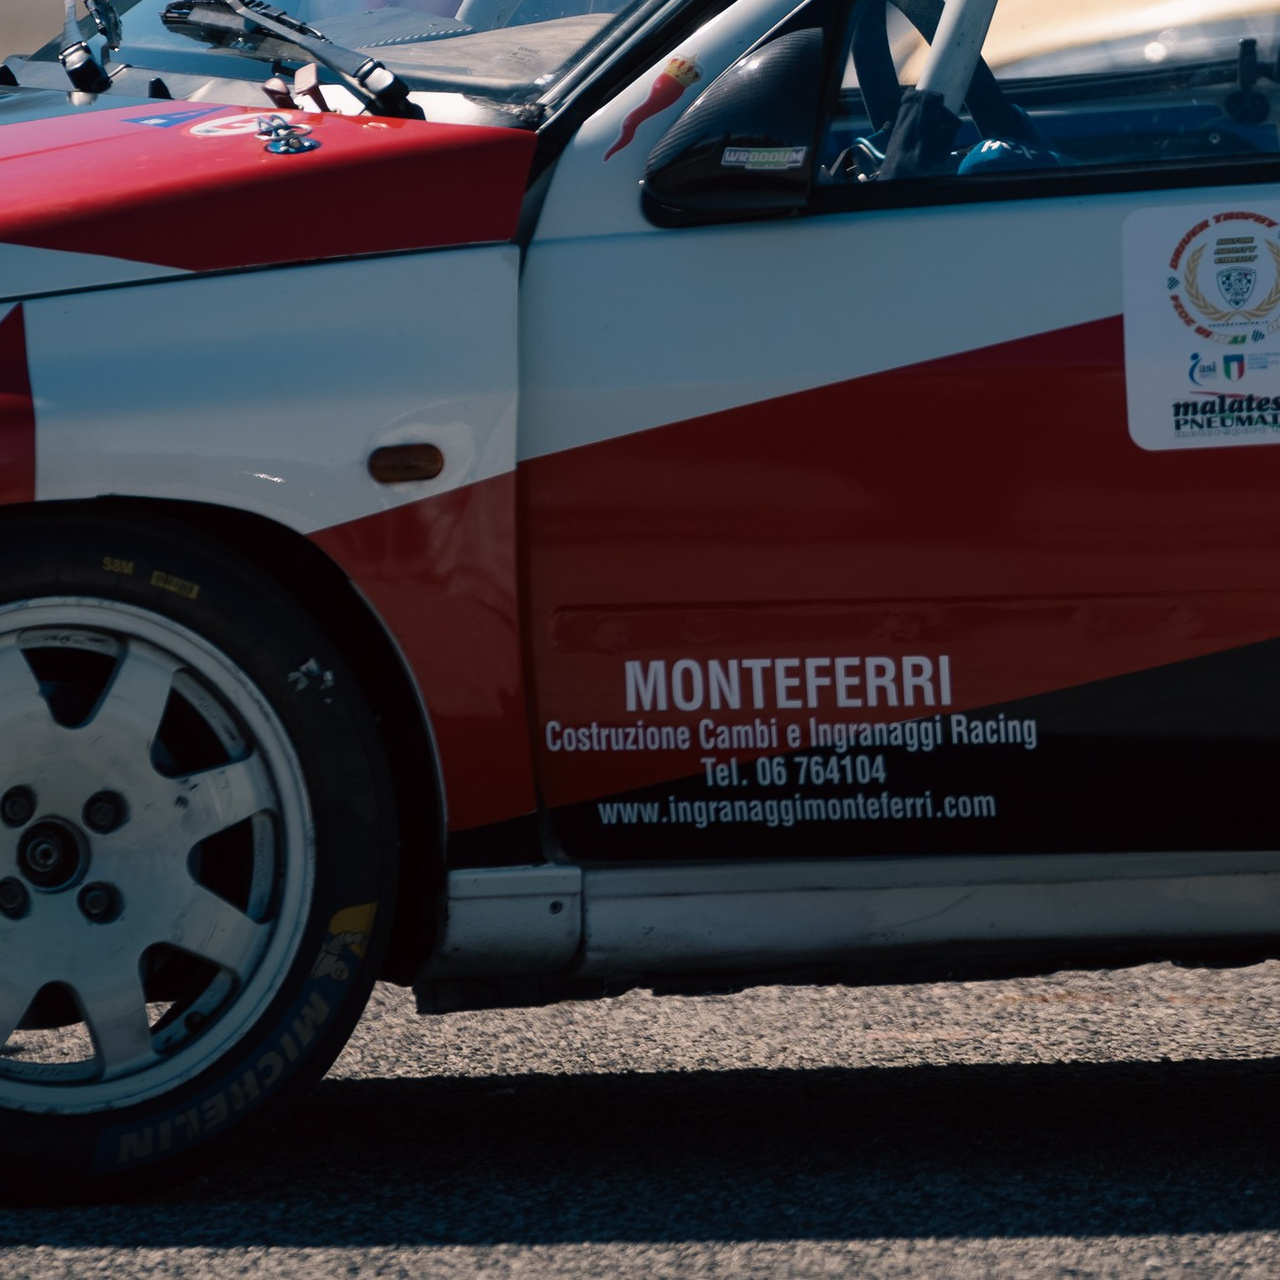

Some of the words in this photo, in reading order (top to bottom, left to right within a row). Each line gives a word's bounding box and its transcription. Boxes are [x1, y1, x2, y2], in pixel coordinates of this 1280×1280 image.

[1169, 218, 1210, 270] DRIVER
[1212, 211, 1279, 228] TROPHY
[1213, 245, 1258, 255] ABILITY
[1216, 237, 1255, 246] MOTOR
[1214, 255, 1258, 264] CIRCUIT
[624, 655, 952, 711] MONTEFERRI
[545, 720, 690, 751] Costruzione
[700, 718, 778, 750] Cambi
[787, 724, 800, 748] e
[810, 716, 942, 753] Ingranaggi
[950, 713, 1037, 749] Racing
[701, 757, 748, 787] Tel.
[756, 757, 787, 786] 06
[794, 755, 886, 785] 764104
[598, 791, 997, 828] www.ingranaggimonteferri.com
[117, 990, 330, 1163] MICHELIN
